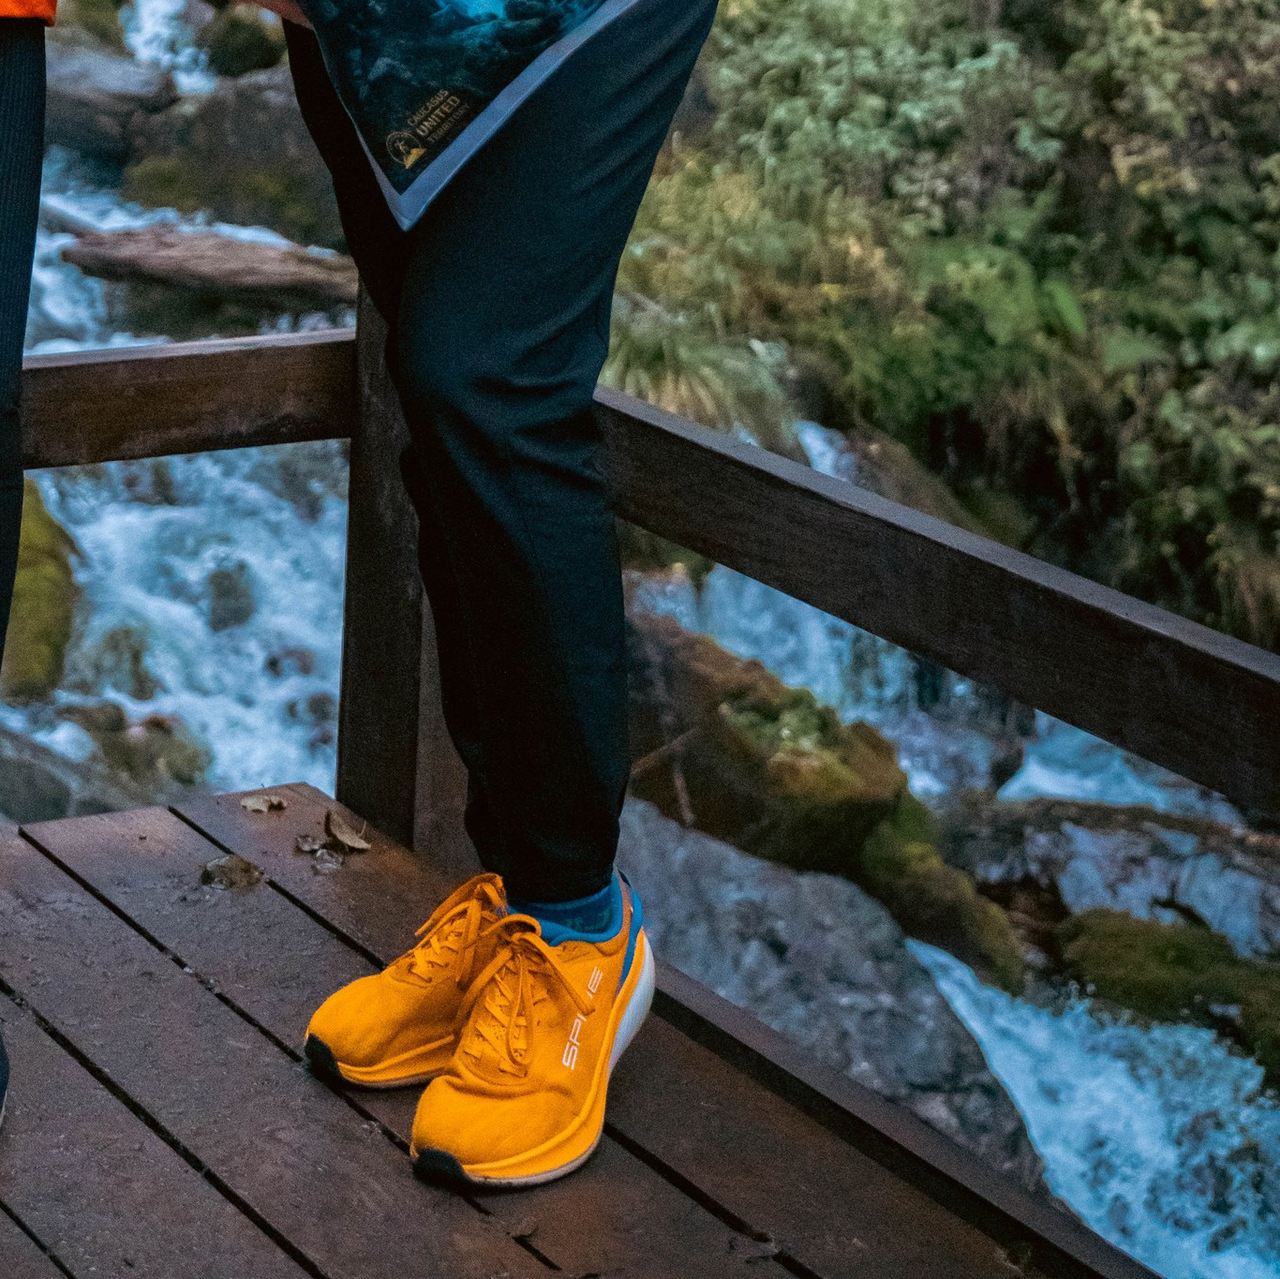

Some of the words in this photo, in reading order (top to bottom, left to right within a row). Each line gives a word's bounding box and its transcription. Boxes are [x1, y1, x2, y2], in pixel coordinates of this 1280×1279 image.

[407, 89, 449, 126] CAUCASUS
[415, 95, 460, 136] UNITED
[562, 965, 603, 1070] SPIE
